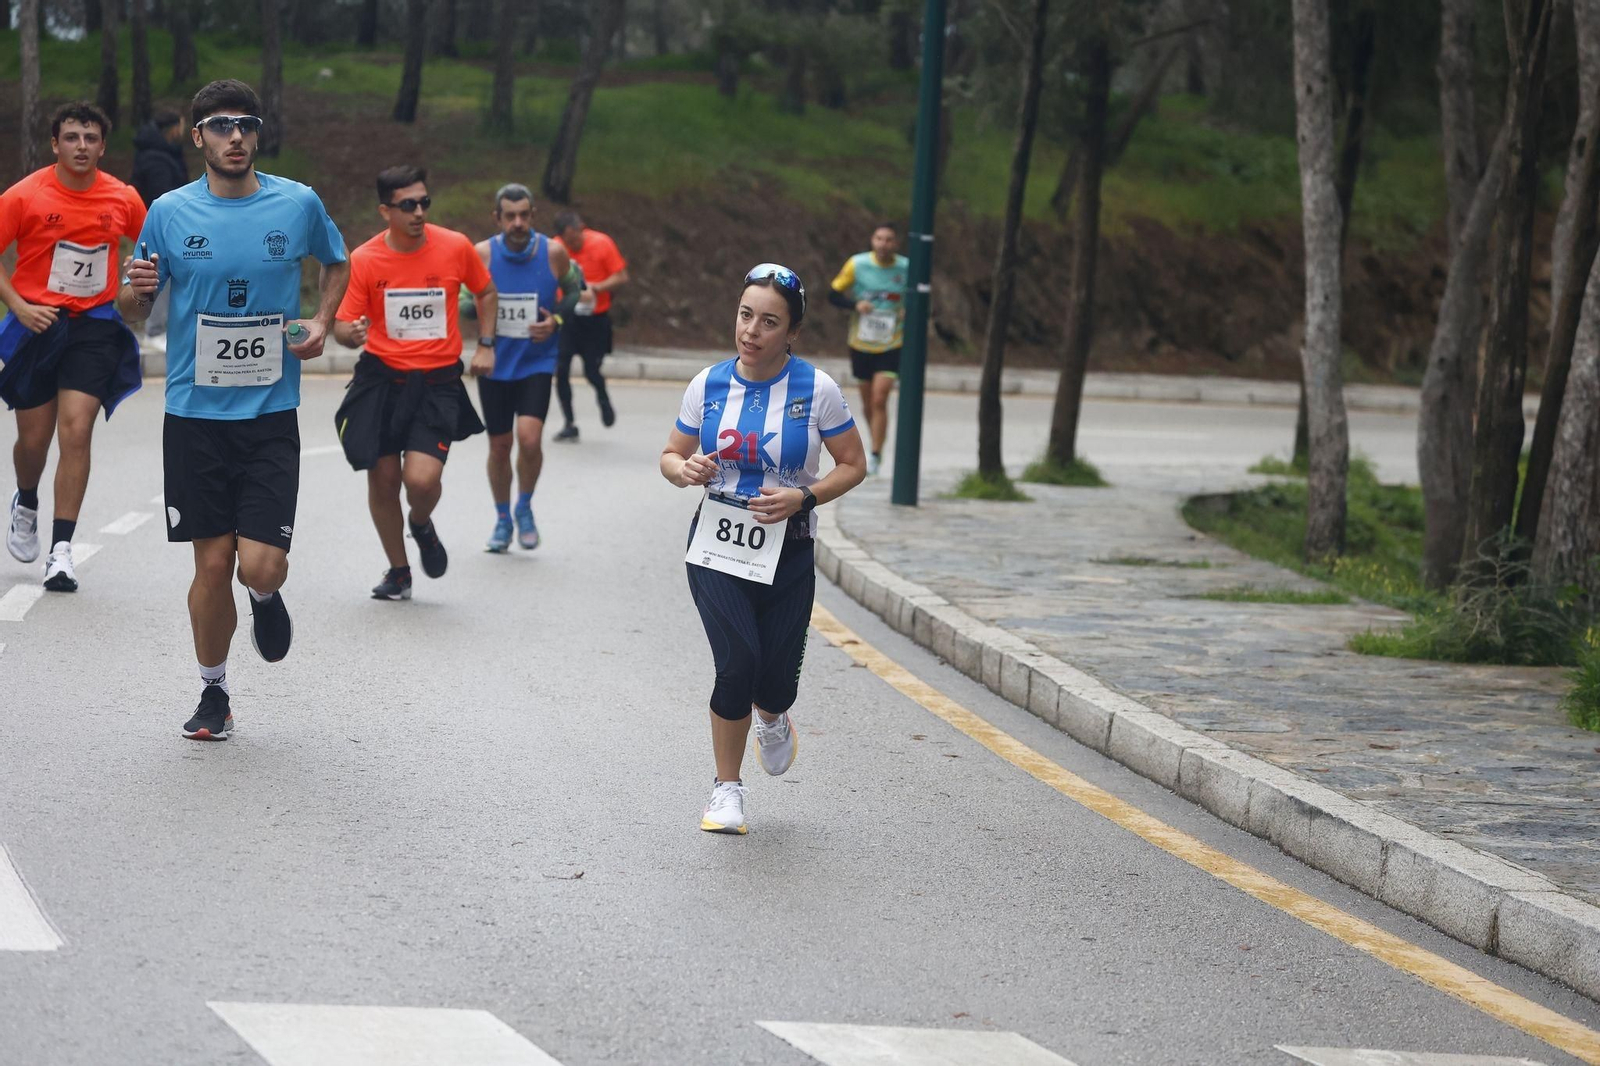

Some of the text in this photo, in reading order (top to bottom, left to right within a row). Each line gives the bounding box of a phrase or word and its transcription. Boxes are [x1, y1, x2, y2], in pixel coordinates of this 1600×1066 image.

[73, 260, 93, 278] 71
[399, 304, 434, 320] 466
[498, 306, 526, 321] 314
[216, 337, 266, 360] 266
[718, 428, 778, 468] 21K
[716, 517, 766, 551] 810
